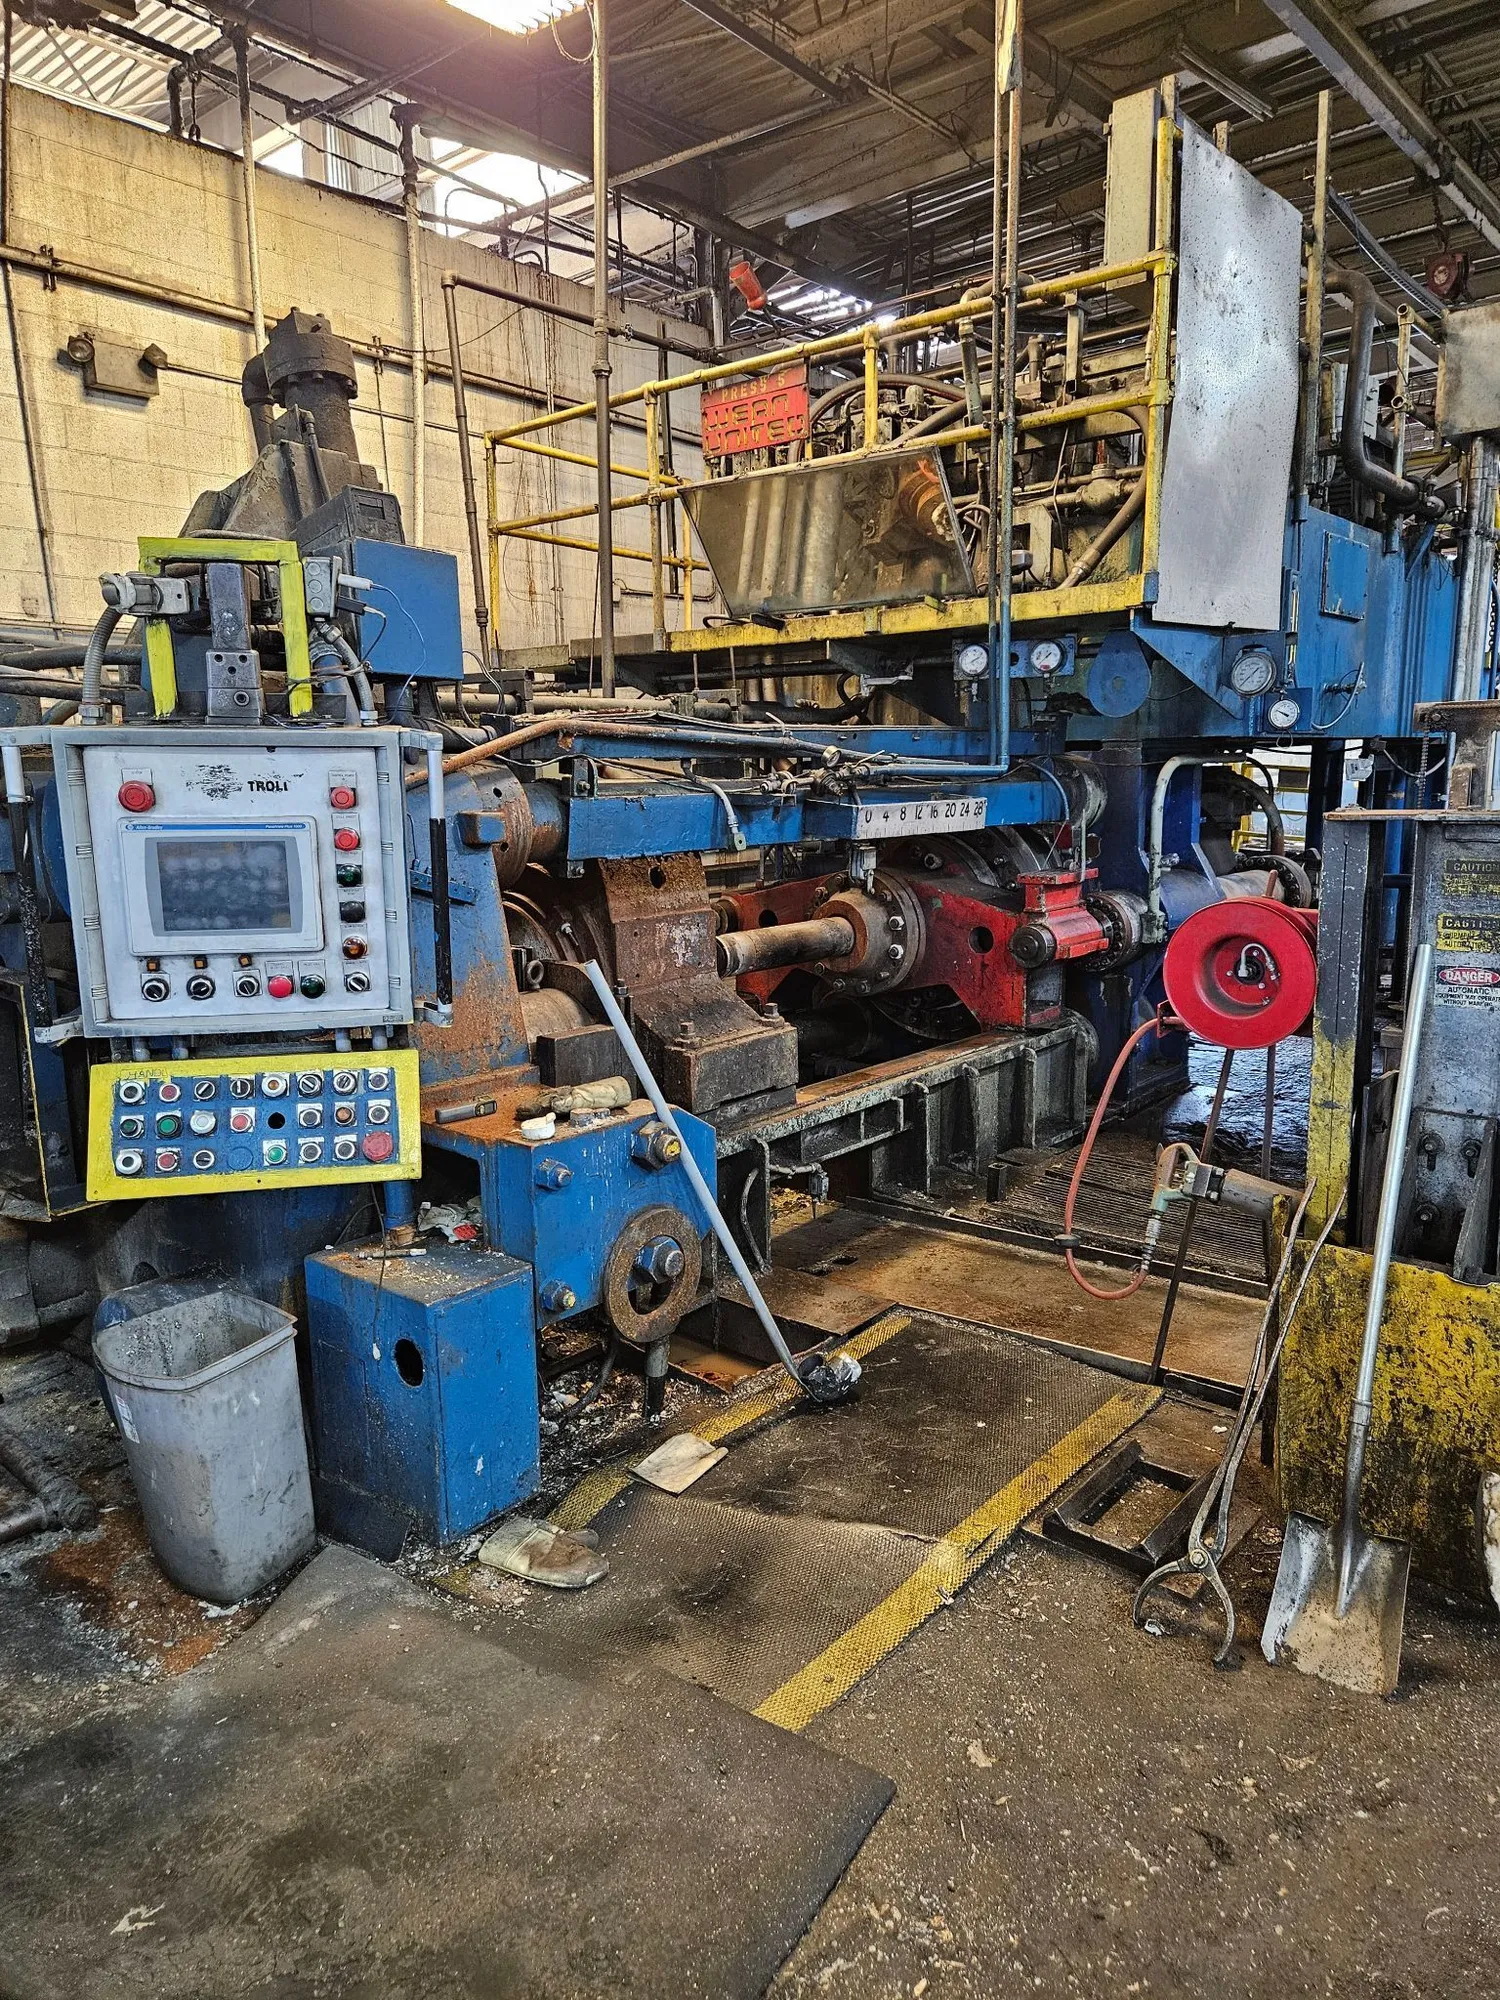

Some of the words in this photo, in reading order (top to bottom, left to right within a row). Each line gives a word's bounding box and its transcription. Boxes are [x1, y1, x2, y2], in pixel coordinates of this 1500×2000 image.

[721, 376, 768, 401] PRESS
[777, 373, 785, 387] 5
[704, 393, 789, 431] WEAN
[703, 414, 807, 455] UNITED
[882, 810, 890, 822] 4
[900, 806, 907, 821] 8
[914, 804, 923, 820] 12
[930, 805, 938, 818] 16
[945, 803, 956, 818] 20
[959, 802, 970, 817] 24
[973, 801, 984, 817] 28
[1446, 970, 1492, 984] DANGER
[1447, 986, 1490, 995] AUTOMATIC
